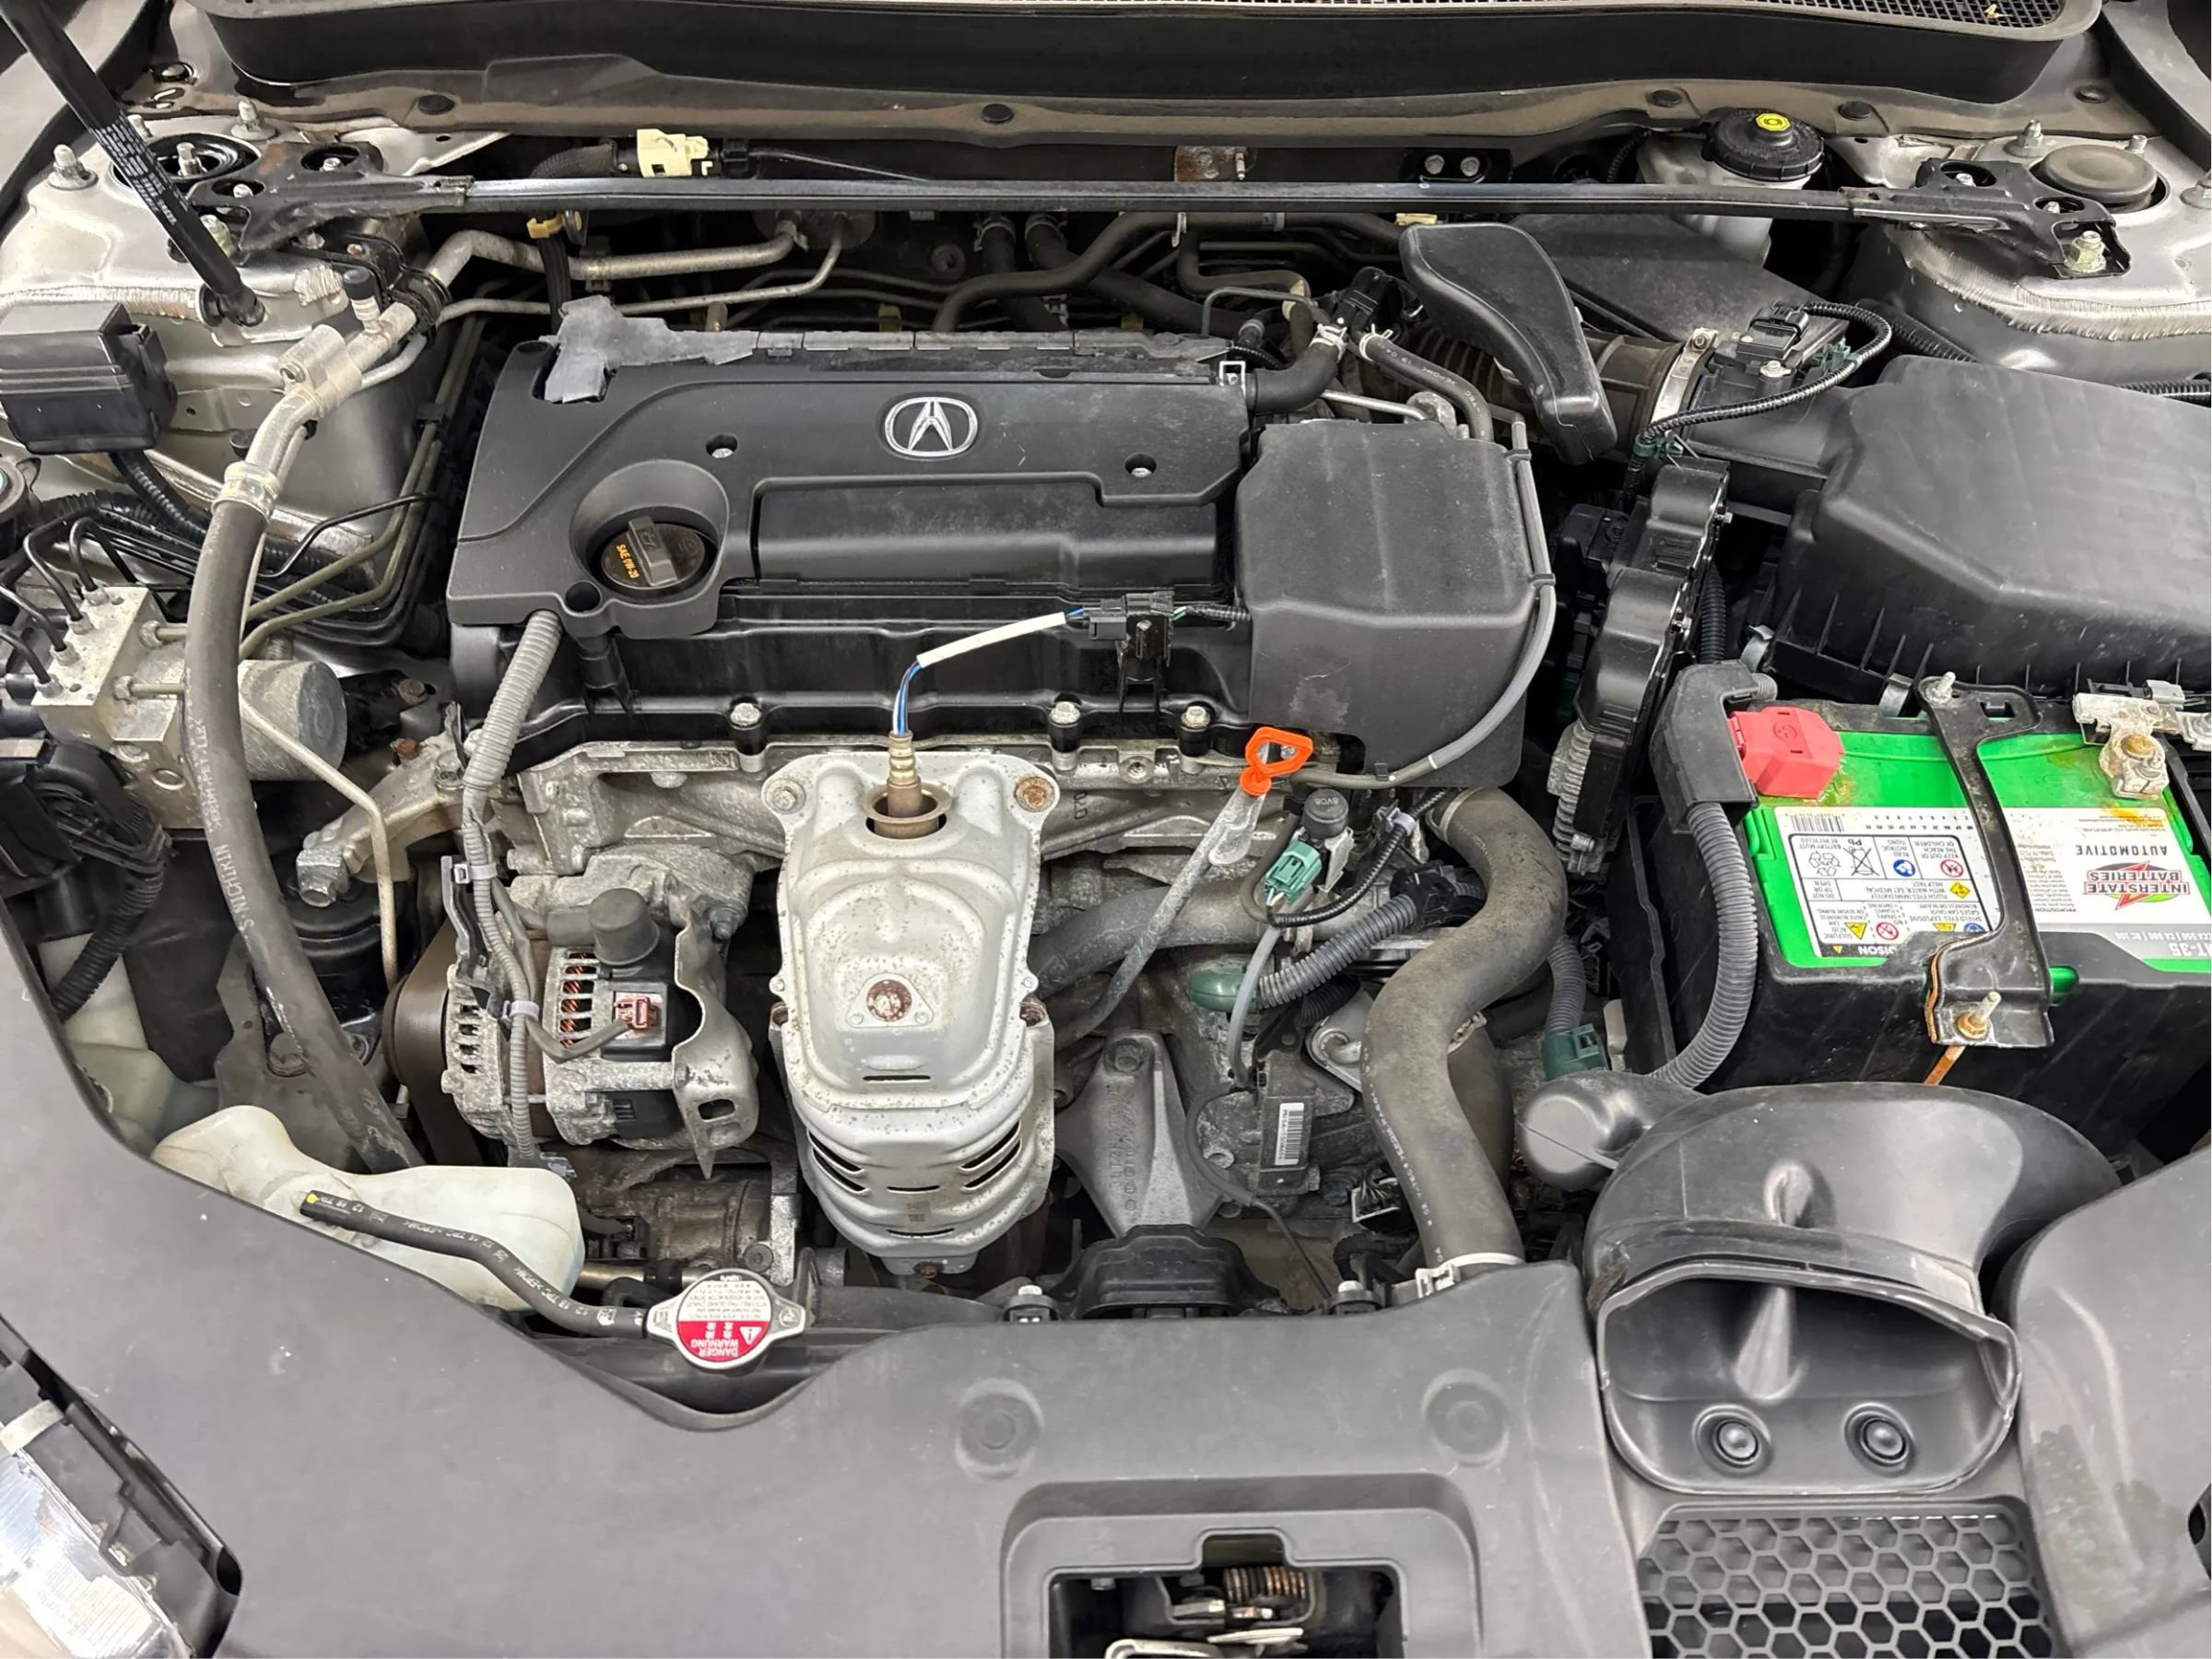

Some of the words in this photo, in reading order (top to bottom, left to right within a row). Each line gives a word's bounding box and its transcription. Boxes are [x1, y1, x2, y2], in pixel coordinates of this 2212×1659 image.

[2075, 845, 2167, 855] AUTOMOTIVE
[2088, 872, 2179, 881] BATTERIES
[2088, 884, 2187, 893] INTERSTATE
[690, 1338, 738, 1348] WARNUNG
[699, 1348, 738, 1357] DANGER
